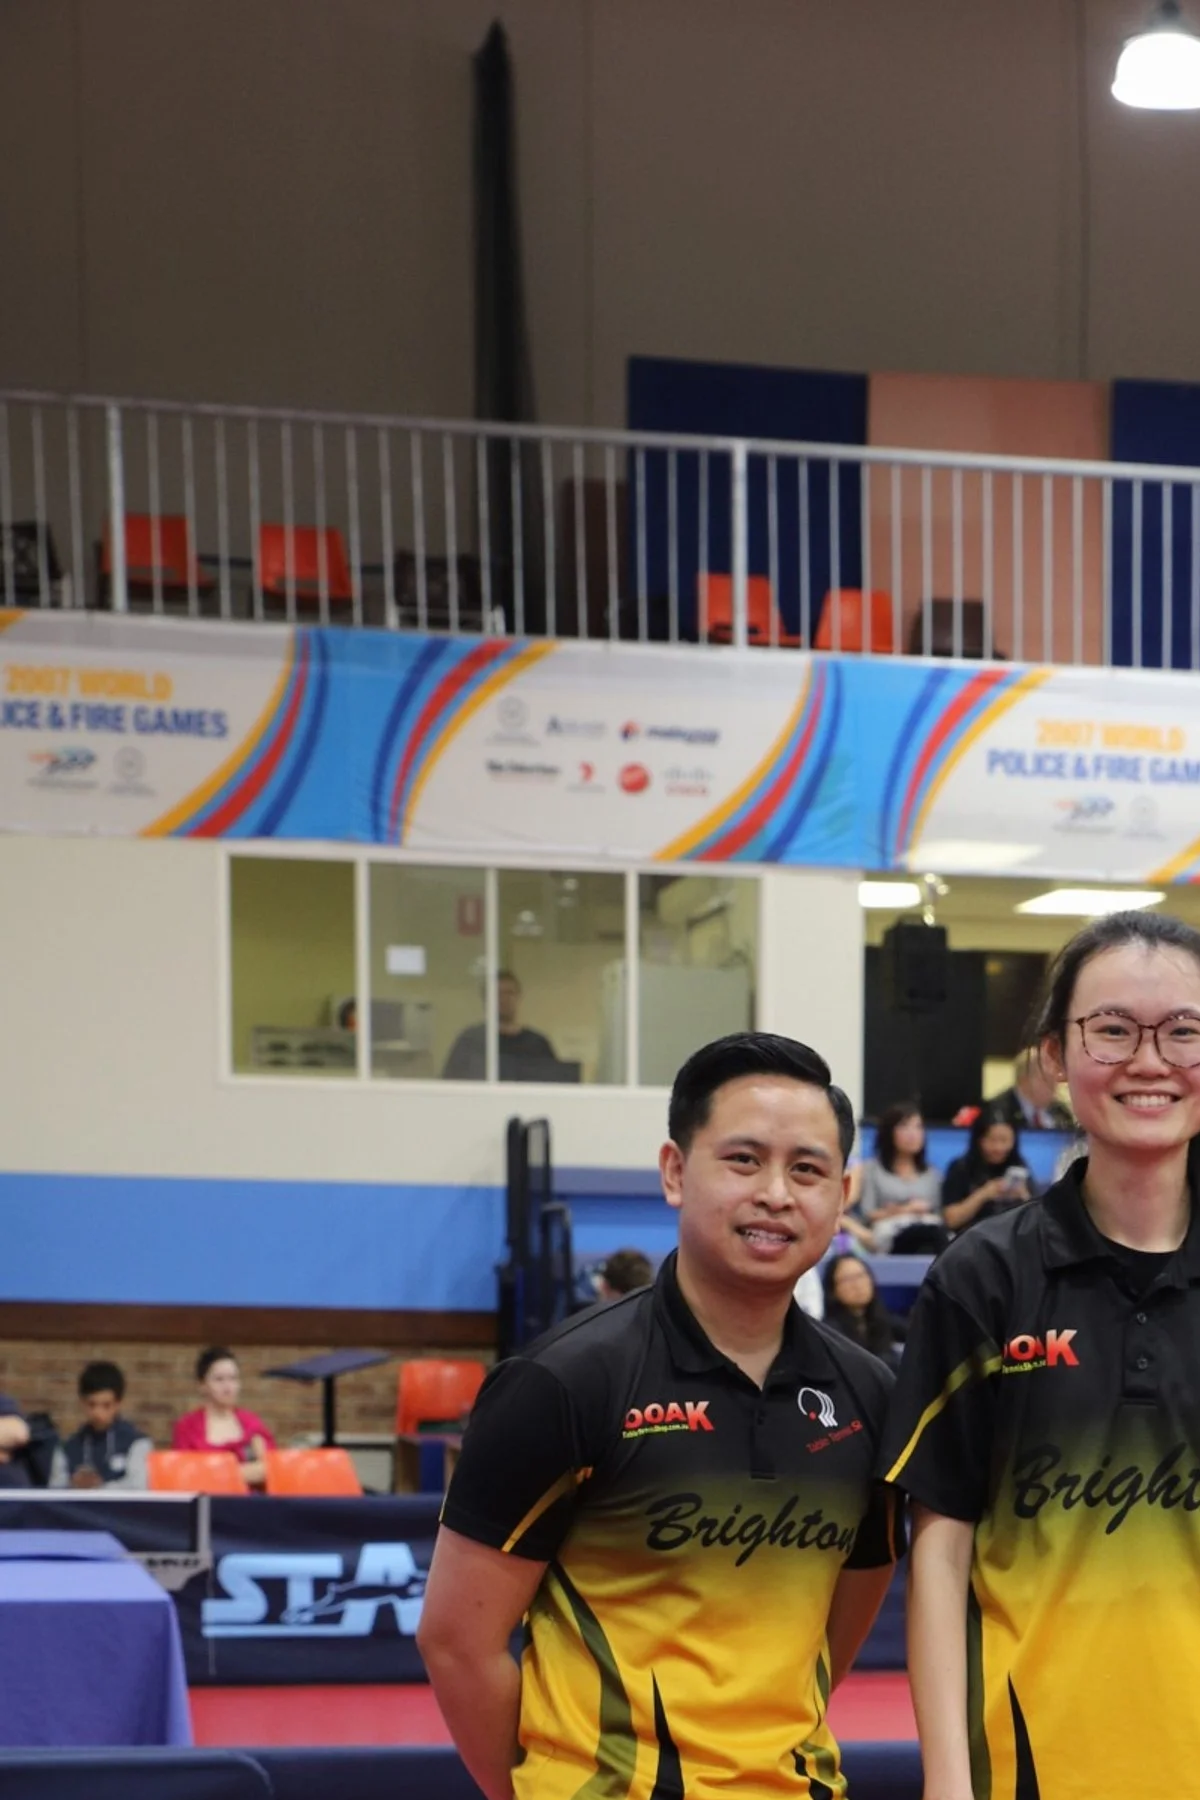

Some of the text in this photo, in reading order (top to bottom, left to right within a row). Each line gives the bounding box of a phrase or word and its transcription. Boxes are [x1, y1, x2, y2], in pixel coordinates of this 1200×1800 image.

[78, 671, 172, 702] WORLD
[0, 701, 228, 739] ICE & FIRE GAMES
[1101, 724, 1185, 753] WORLD
[987, 749, 1066, 778] POLICE
[1074, 753, 1088, 778] &
[1094, 754, 1142, 782] FIRE
[624, 1400, 714, 1432] DOAK
[645, 1493, 858, 1568] Brighton
[202, 1542, 427, 1638] STA
